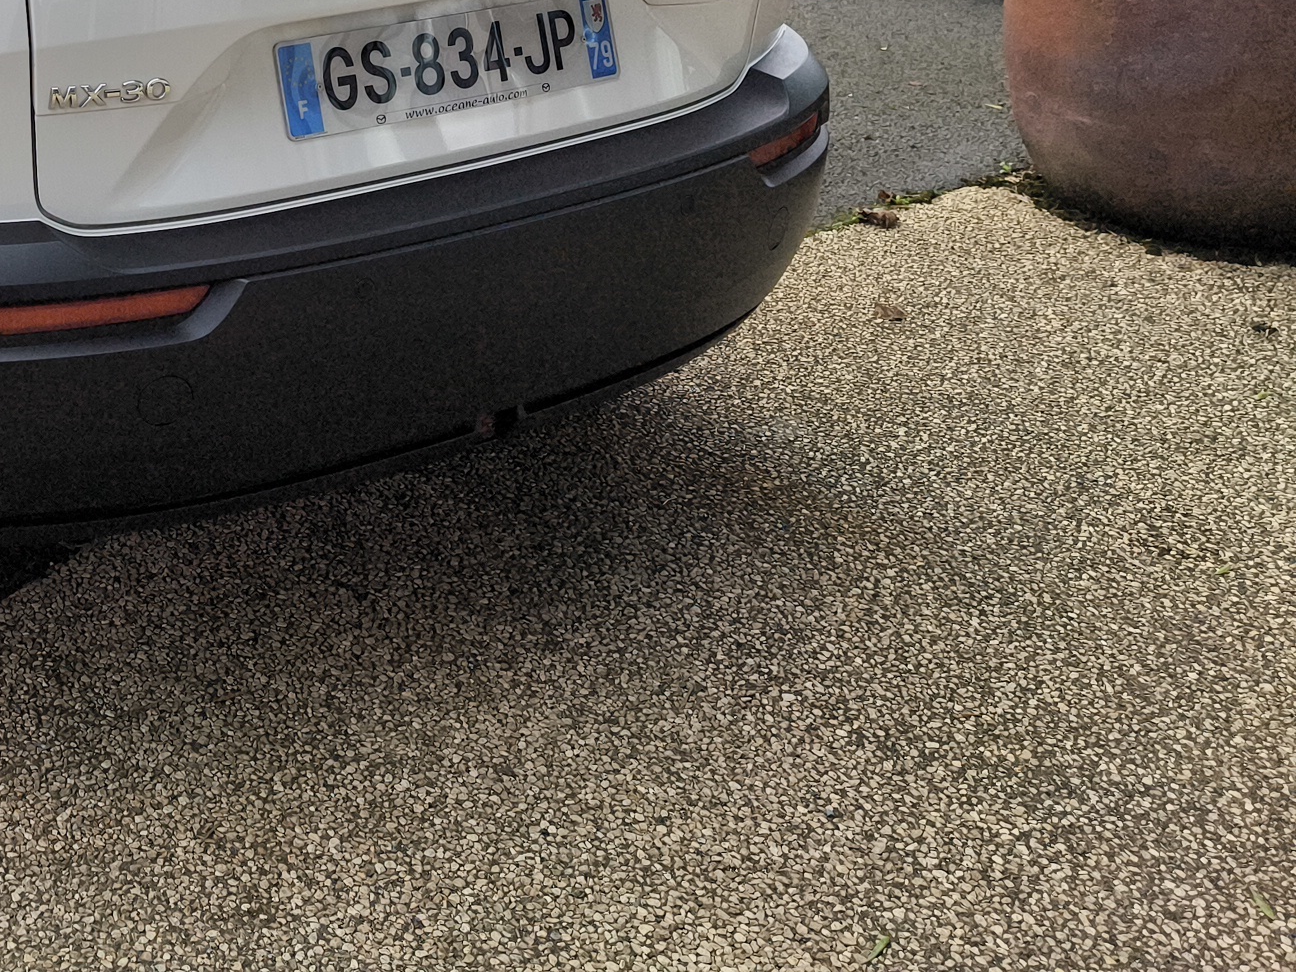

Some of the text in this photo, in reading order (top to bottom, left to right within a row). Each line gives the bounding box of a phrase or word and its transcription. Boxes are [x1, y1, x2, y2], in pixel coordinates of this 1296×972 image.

[323, 9, 575, 111] GS-834-JP
[588, 40, 614, 70] 79
[49, 78, 171, 110] MX-30
[297, 100, 309, 120] F
